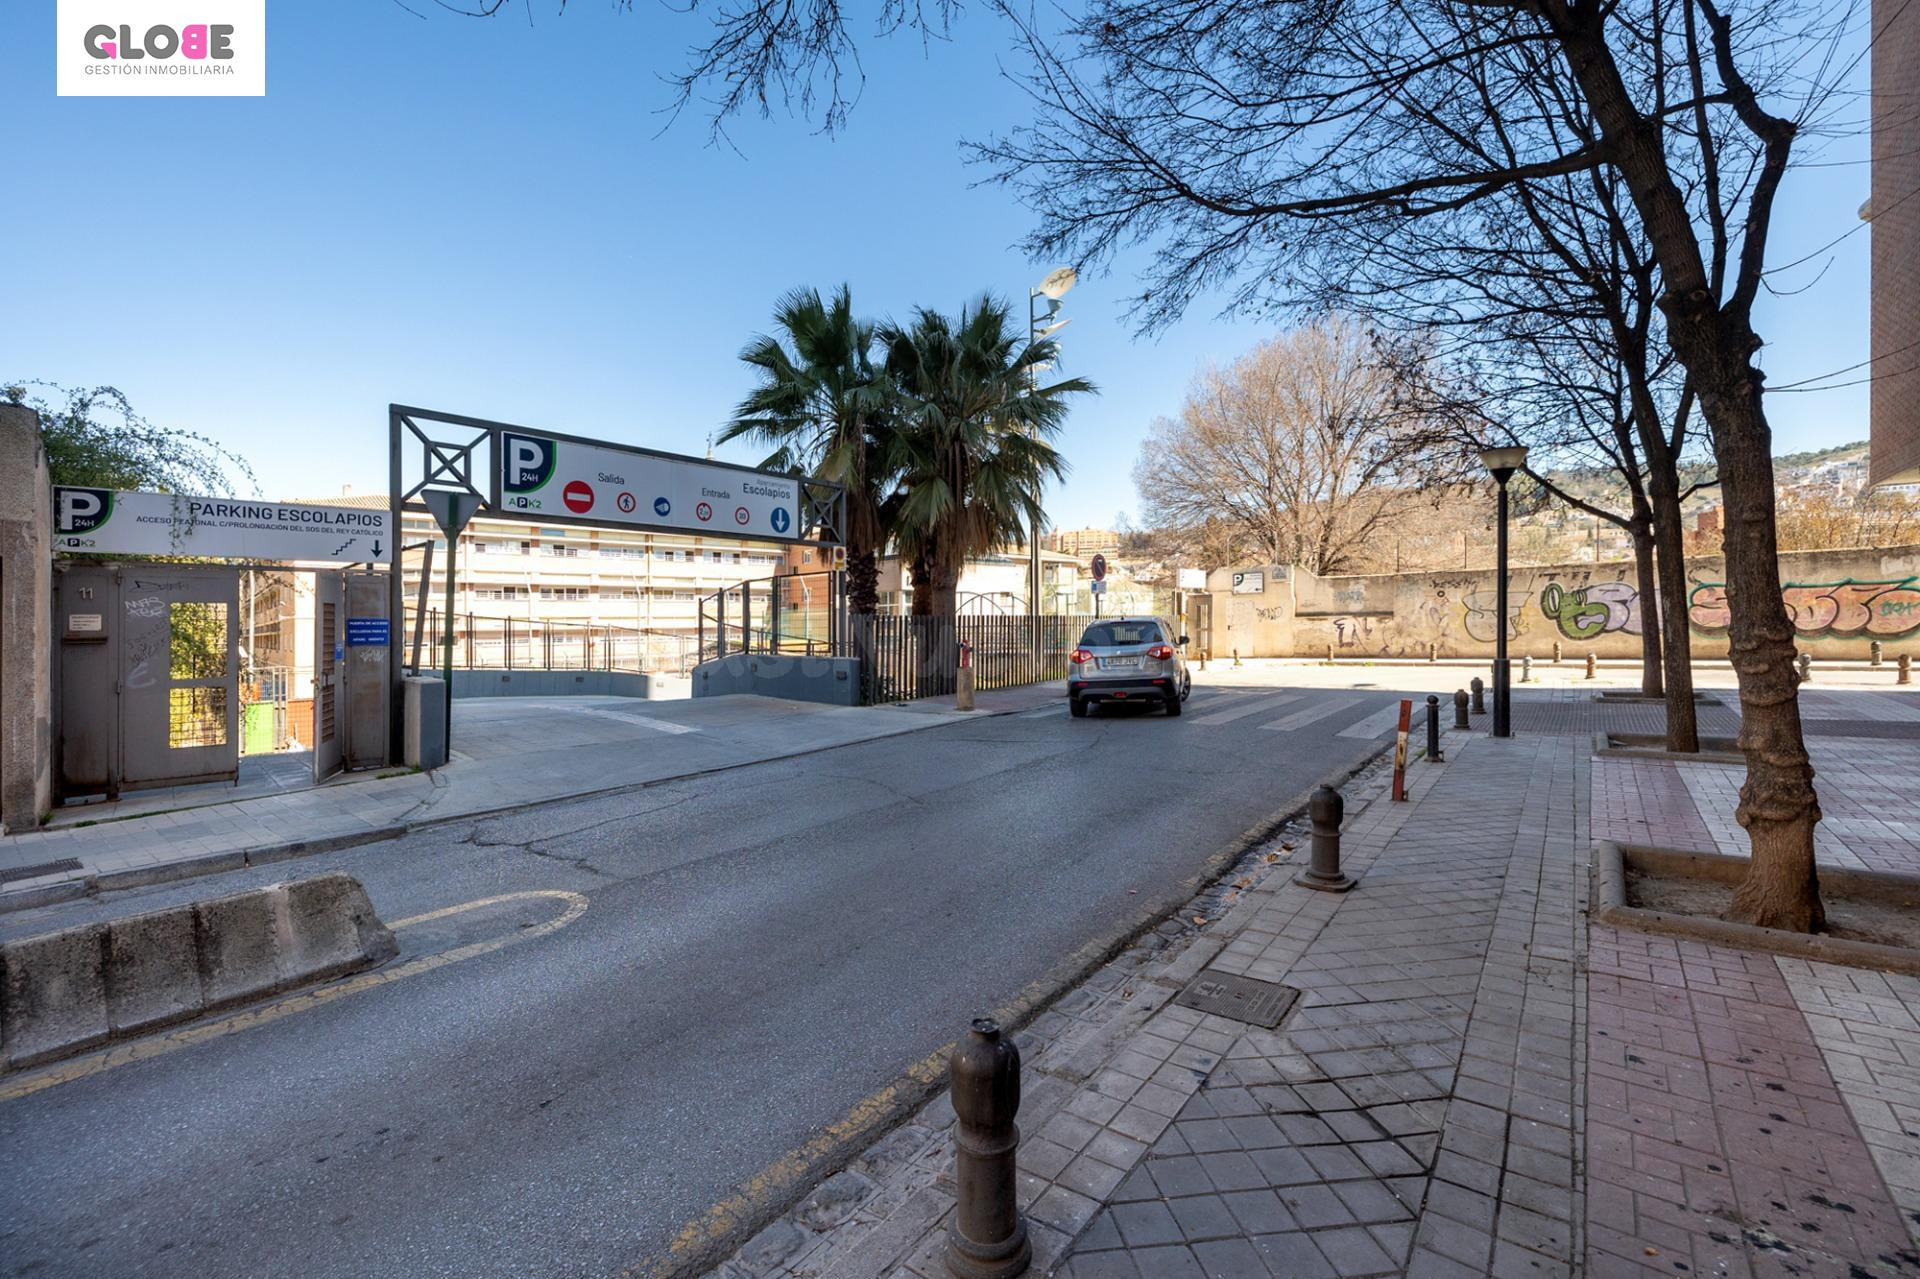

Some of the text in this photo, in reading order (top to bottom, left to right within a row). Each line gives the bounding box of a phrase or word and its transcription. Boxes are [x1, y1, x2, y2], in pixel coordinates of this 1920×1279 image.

[510, 438, 544, 486] P
[521, 471, 539, 482] 24H
[598, 471, 625, 485] Salida
[701, 487, 731, 500] Entrada
[742, 482, 791, 499] Escolapios
[60, 490, 102, 531] P
[190, 501, 383, 528] PARKING ESCOLAPIOS
[74, 518, 95, 528] 24H
[136, 515, 172, 525] ACCESO
[289, 524, 304, 532] DEL
[321, 526, 335, 534] DEL
[336, 527, 350, 535] REY
[79, 587, 94, 600] 11
